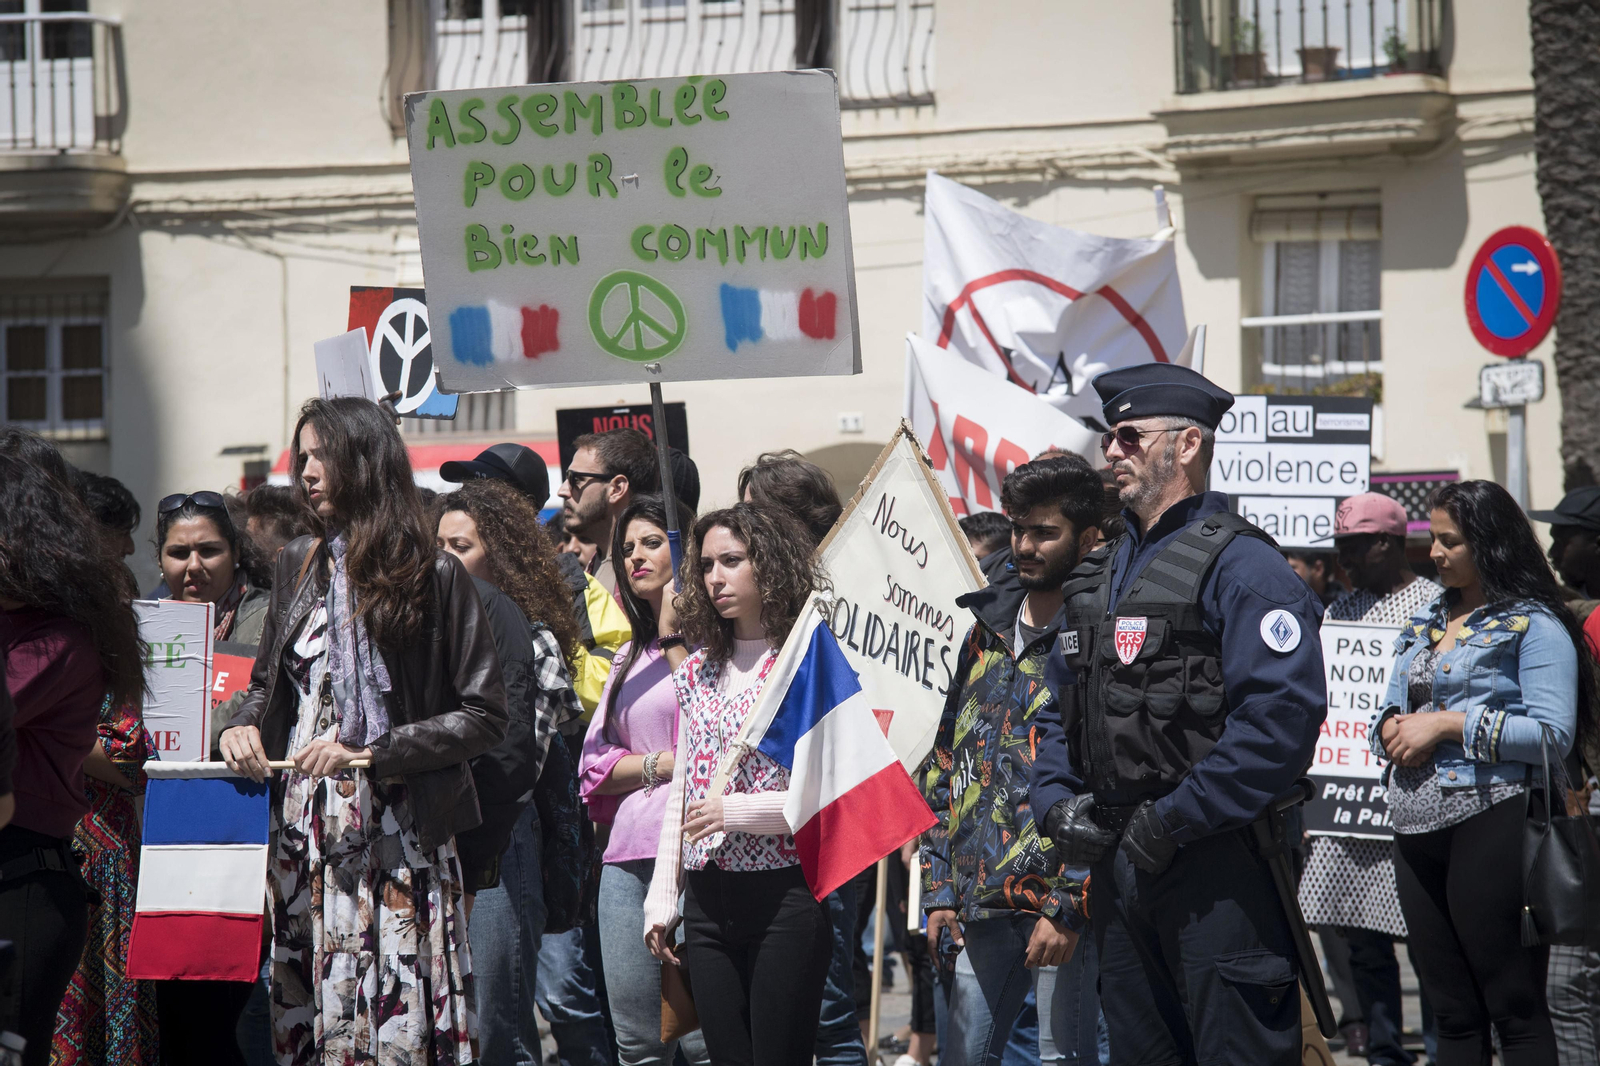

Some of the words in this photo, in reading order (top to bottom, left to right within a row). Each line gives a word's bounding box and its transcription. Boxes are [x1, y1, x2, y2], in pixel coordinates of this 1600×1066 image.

[464, 152, 618, 208] POUR
[664, 146, 723, 198] le
[630, 222, 829, 266] COMMUN
[1271, 410, 1309, 433] au
[1218, 451, 1366, 490] violence,
[872, 492, 928, 568] Nous
[1243, 505, 1330, 538] haine
[883, 574, 954, 642] sommes
[1118, 632, 1142, 644] CRS
[1336, 638, 1382, 657] PAS
[1330, 664, 1385, 684] NOM
[1319, 747, 1350, 765] DE
[1322, 783, 1364, 802] Prêt
[1333, 806, 1352, 824] la
